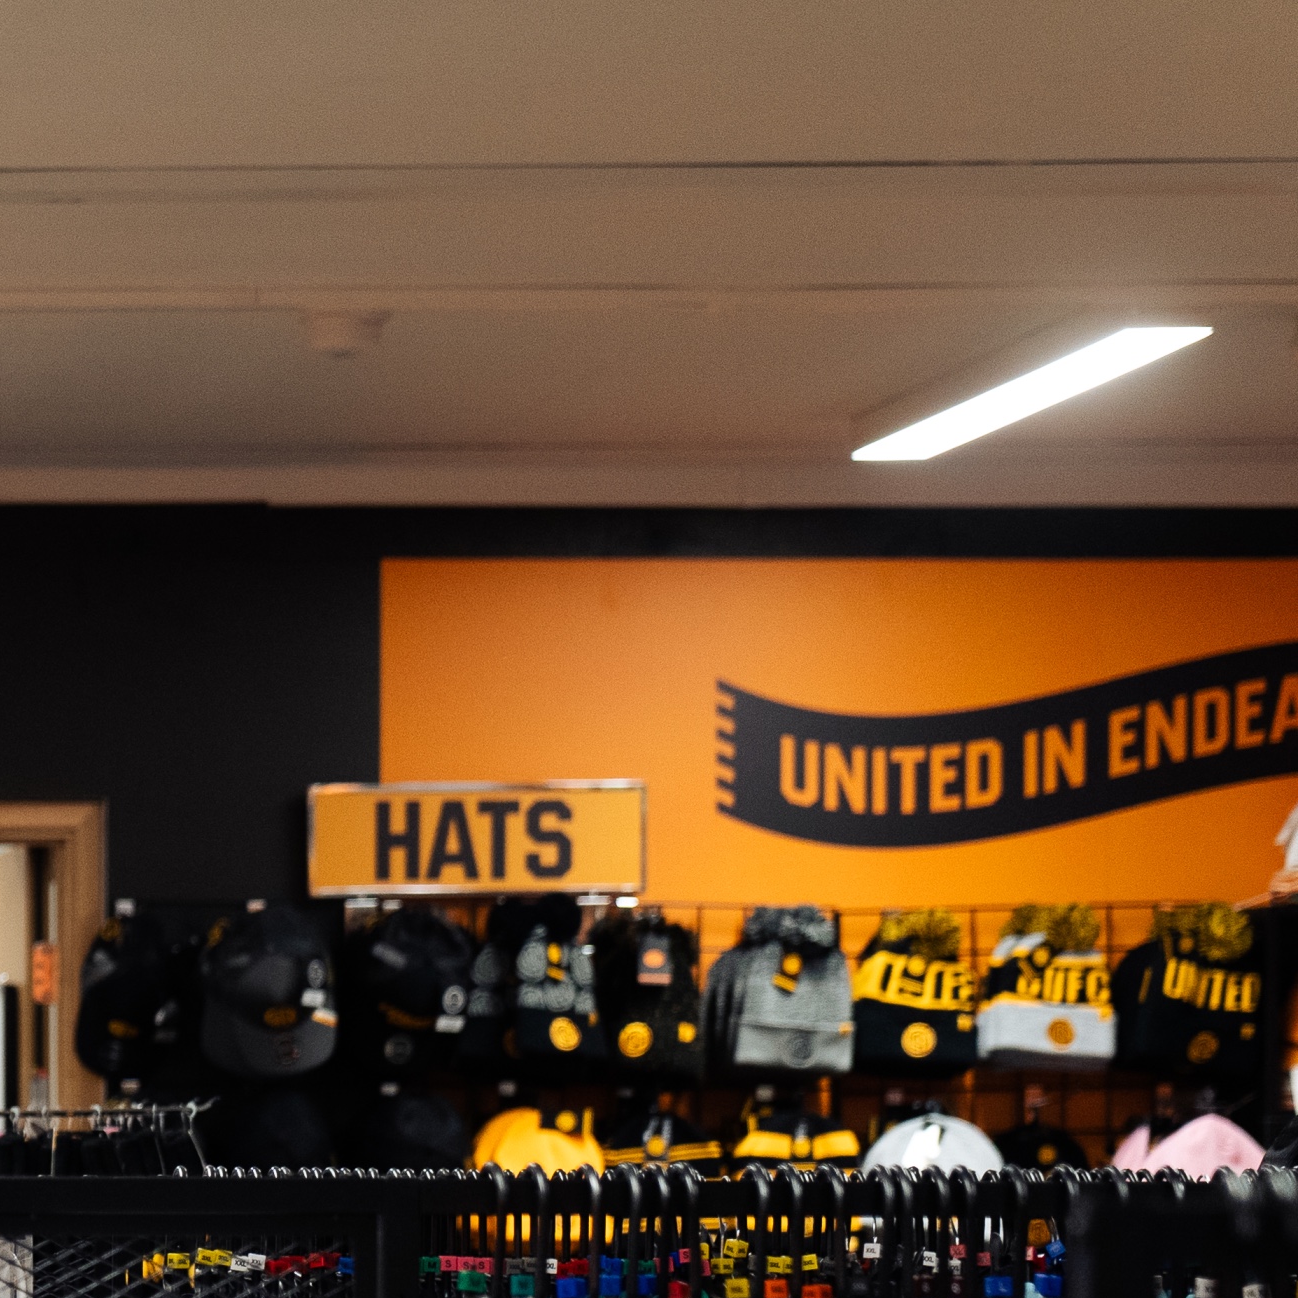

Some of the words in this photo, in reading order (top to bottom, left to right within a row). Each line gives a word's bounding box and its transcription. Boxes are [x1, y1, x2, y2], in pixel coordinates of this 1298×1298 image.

[779, 734, 1004, 815] UNITED
[1023, 718, 1087, 798] IN
[374, 800, 573, 880] HATS
